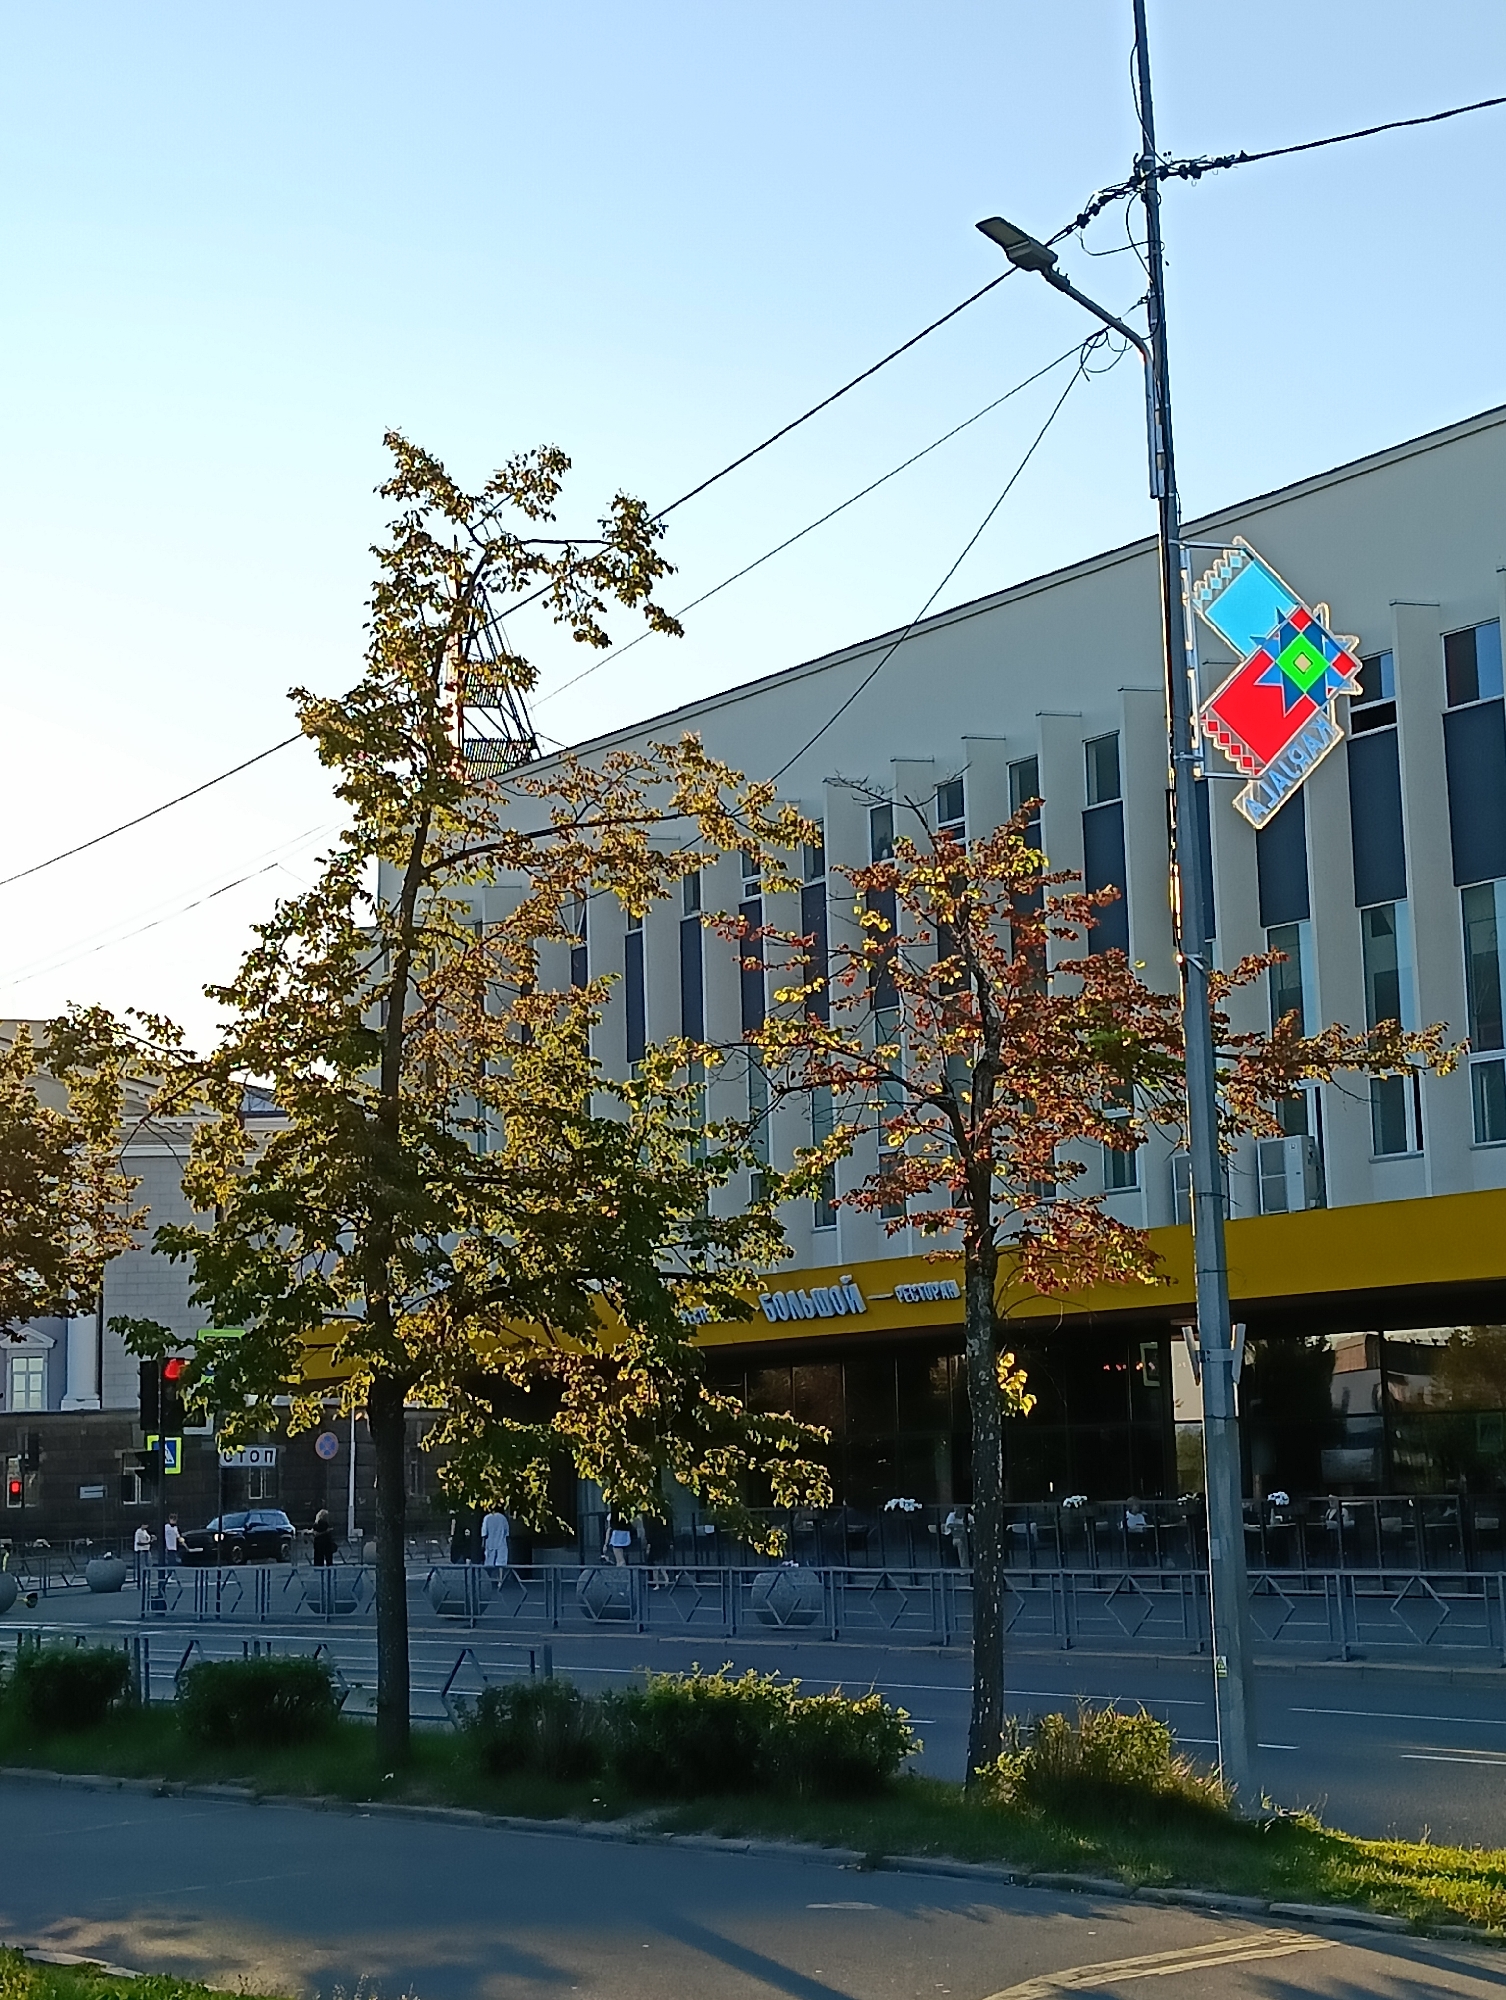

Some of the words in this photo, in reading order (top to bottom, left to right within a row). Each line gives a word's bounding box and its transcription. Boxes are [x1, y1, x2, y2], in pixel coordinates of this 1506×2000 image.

[759, 1275, 867, 1322] БОЛЬШОЙ
[896, 1280, 961, 1303] РЕСТОРАН
[223, 1450, 274, 1463] СТОП
